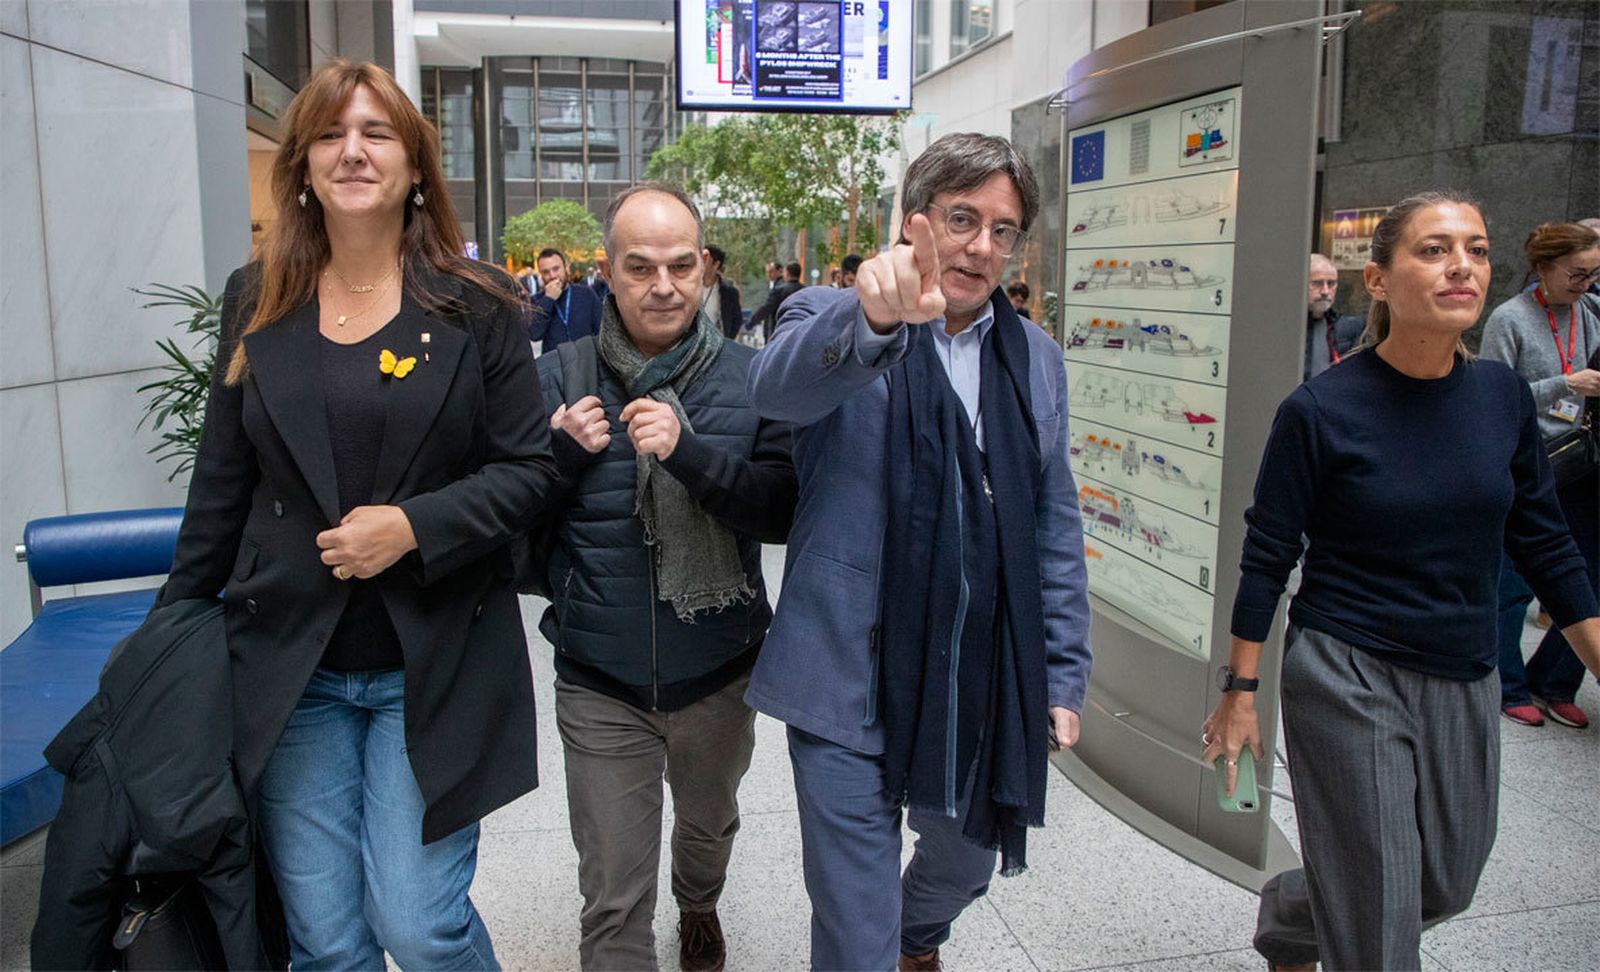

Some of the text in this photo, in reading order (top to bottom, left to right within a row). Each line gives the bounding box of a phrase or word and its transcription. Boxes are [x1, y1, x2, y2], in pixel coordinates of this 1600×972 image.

[759, 60, 837, 69] PYLOS SHIPWRECK
[762, 52, 797, 60] MONTHS
[798, 53, 824, 61] AFTER
[1218, 218, 1226, 235] 7
[1215, 289, 1222, 306] 5
[1211, 361, 1219, 378] 3
[1207, 431, 1215, 448] 2
[1203, 499, 1210, 516] 1
